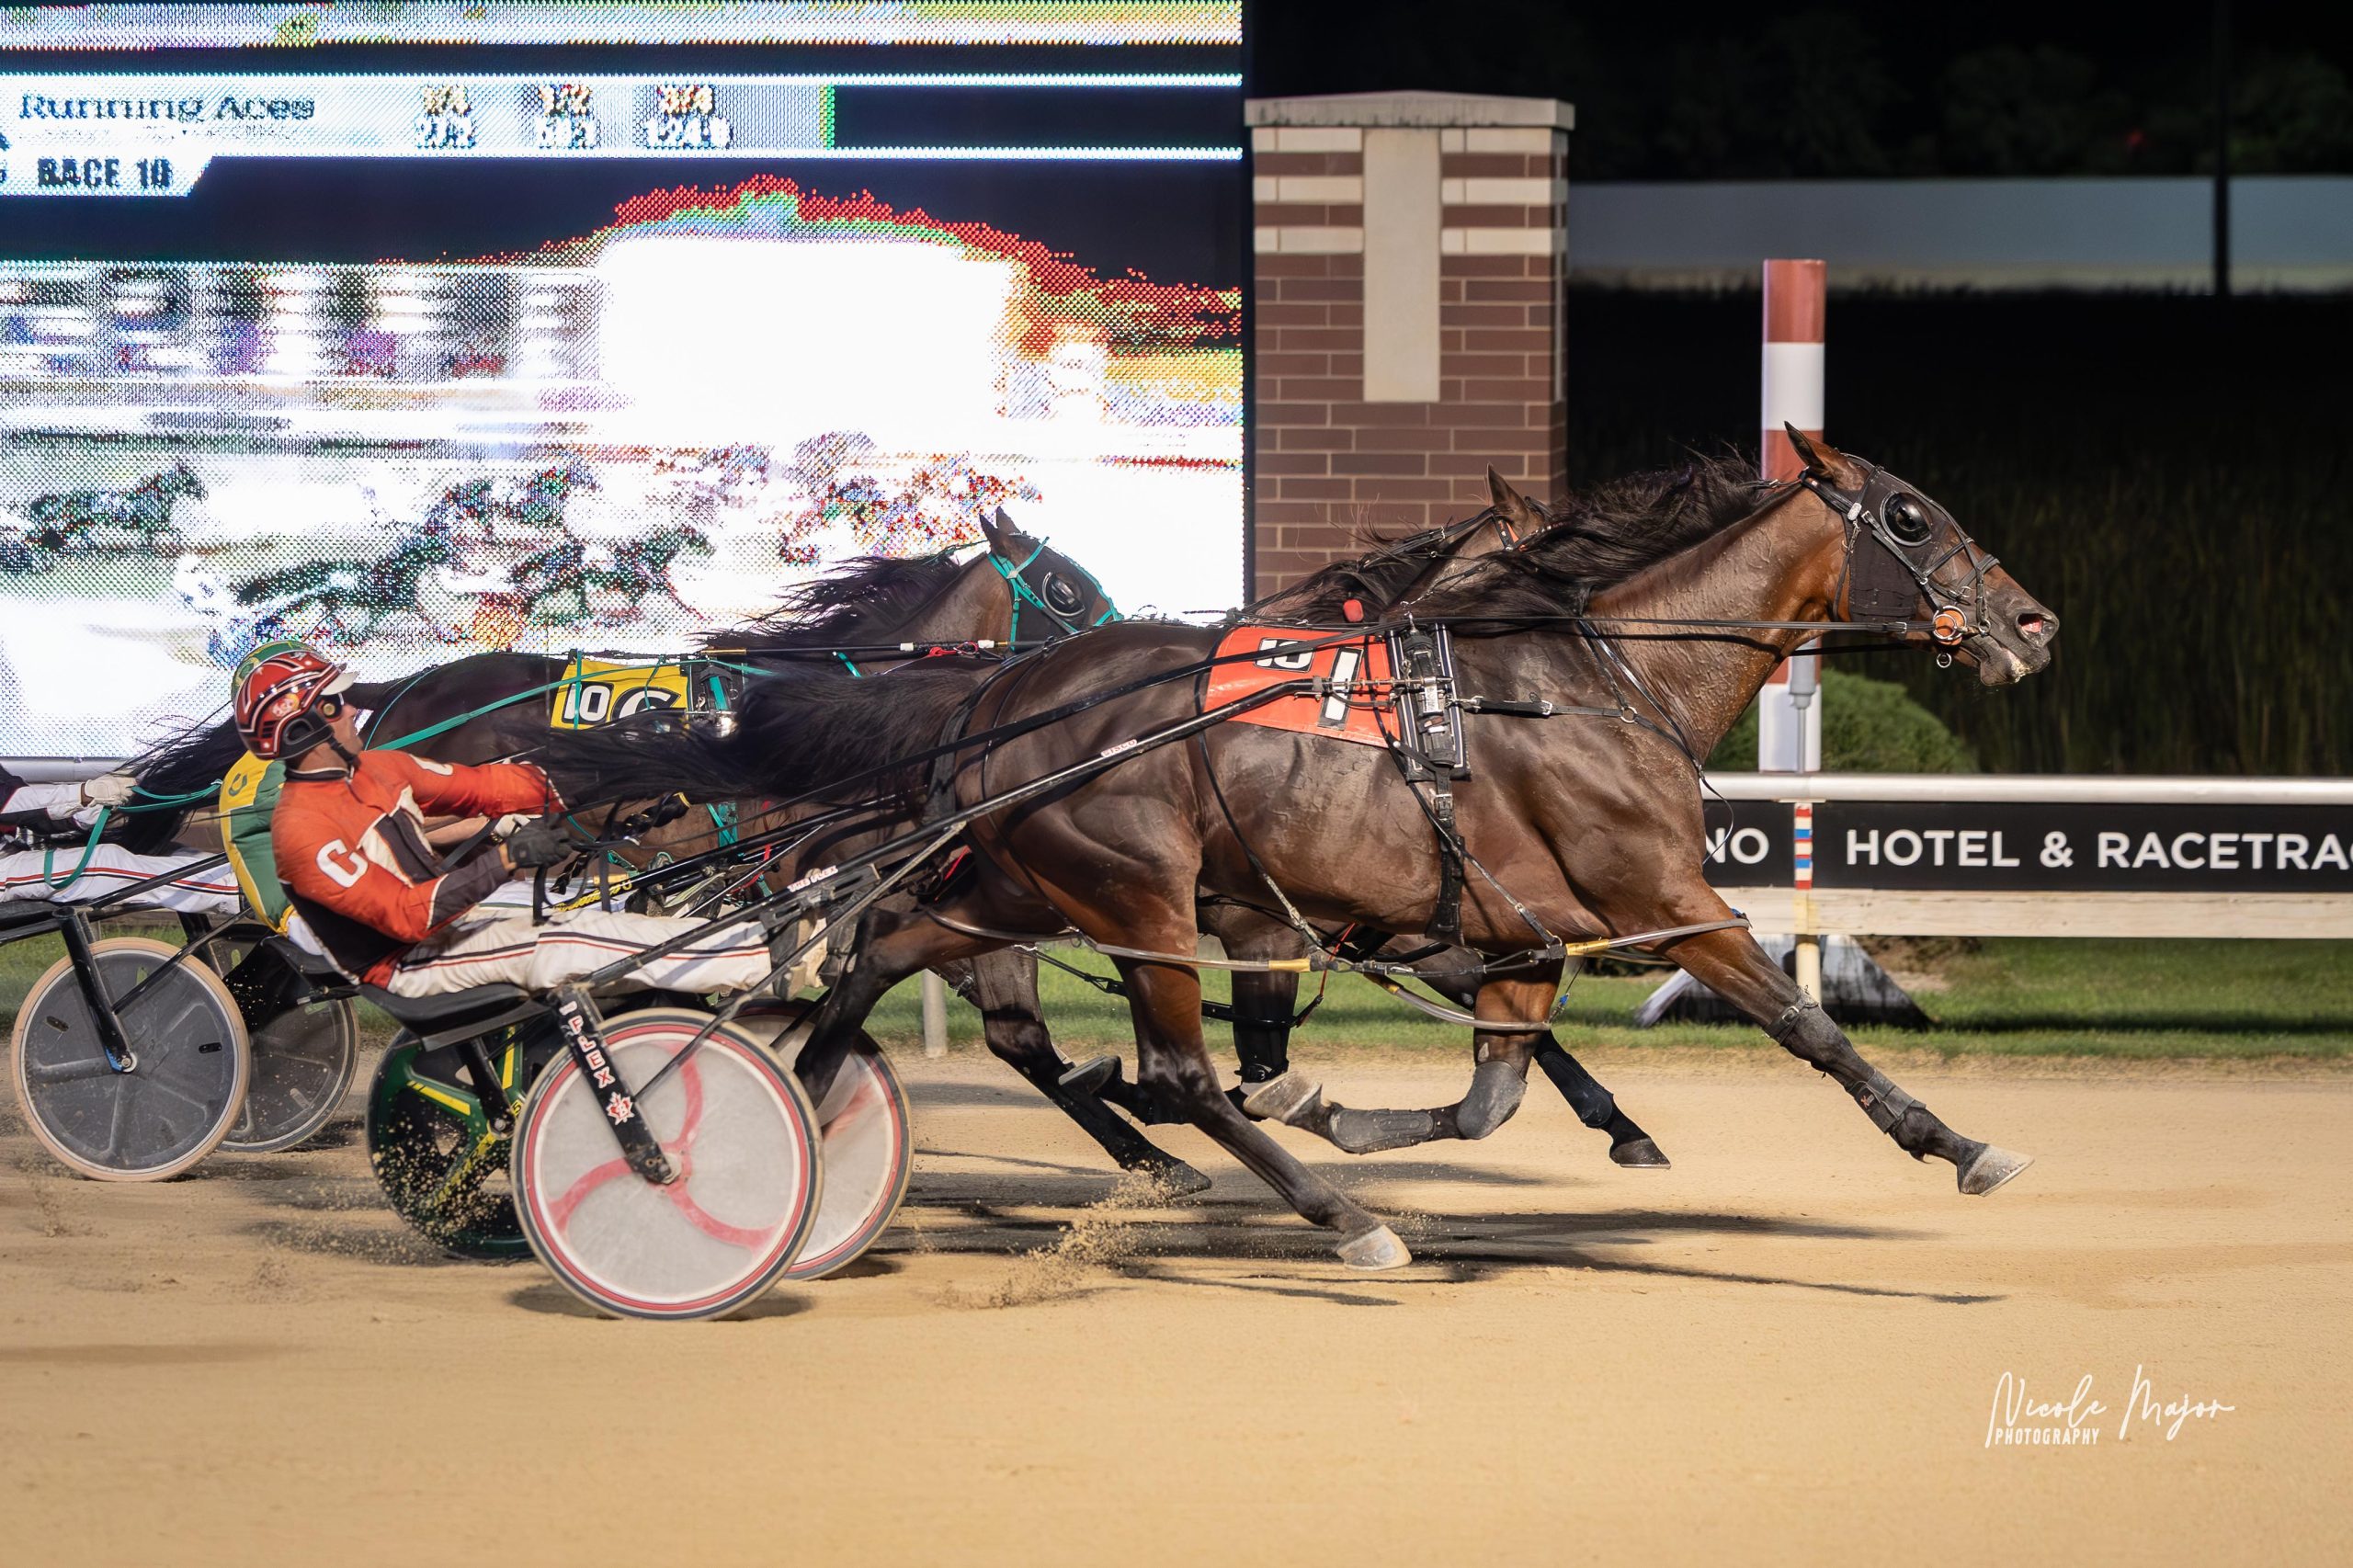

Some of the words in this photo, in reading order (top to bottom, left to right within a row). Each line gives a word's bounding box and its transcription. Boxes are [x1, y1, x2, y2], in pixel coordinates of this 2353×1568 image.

[19, 93, 204, 123] Running
[214, 96, 315, 120] Aces
[38, 157, 119, 187] RACE
[137, 157, 174, 187] 10
[316, 839, 368, 888] C
[1847, 830, 2019, 867] HOTEL
[2040, 831, 2074, 868] &
[2098, 832, 2353, 870] RACETRA
[568, 1015, 615, 1088] FLEX
